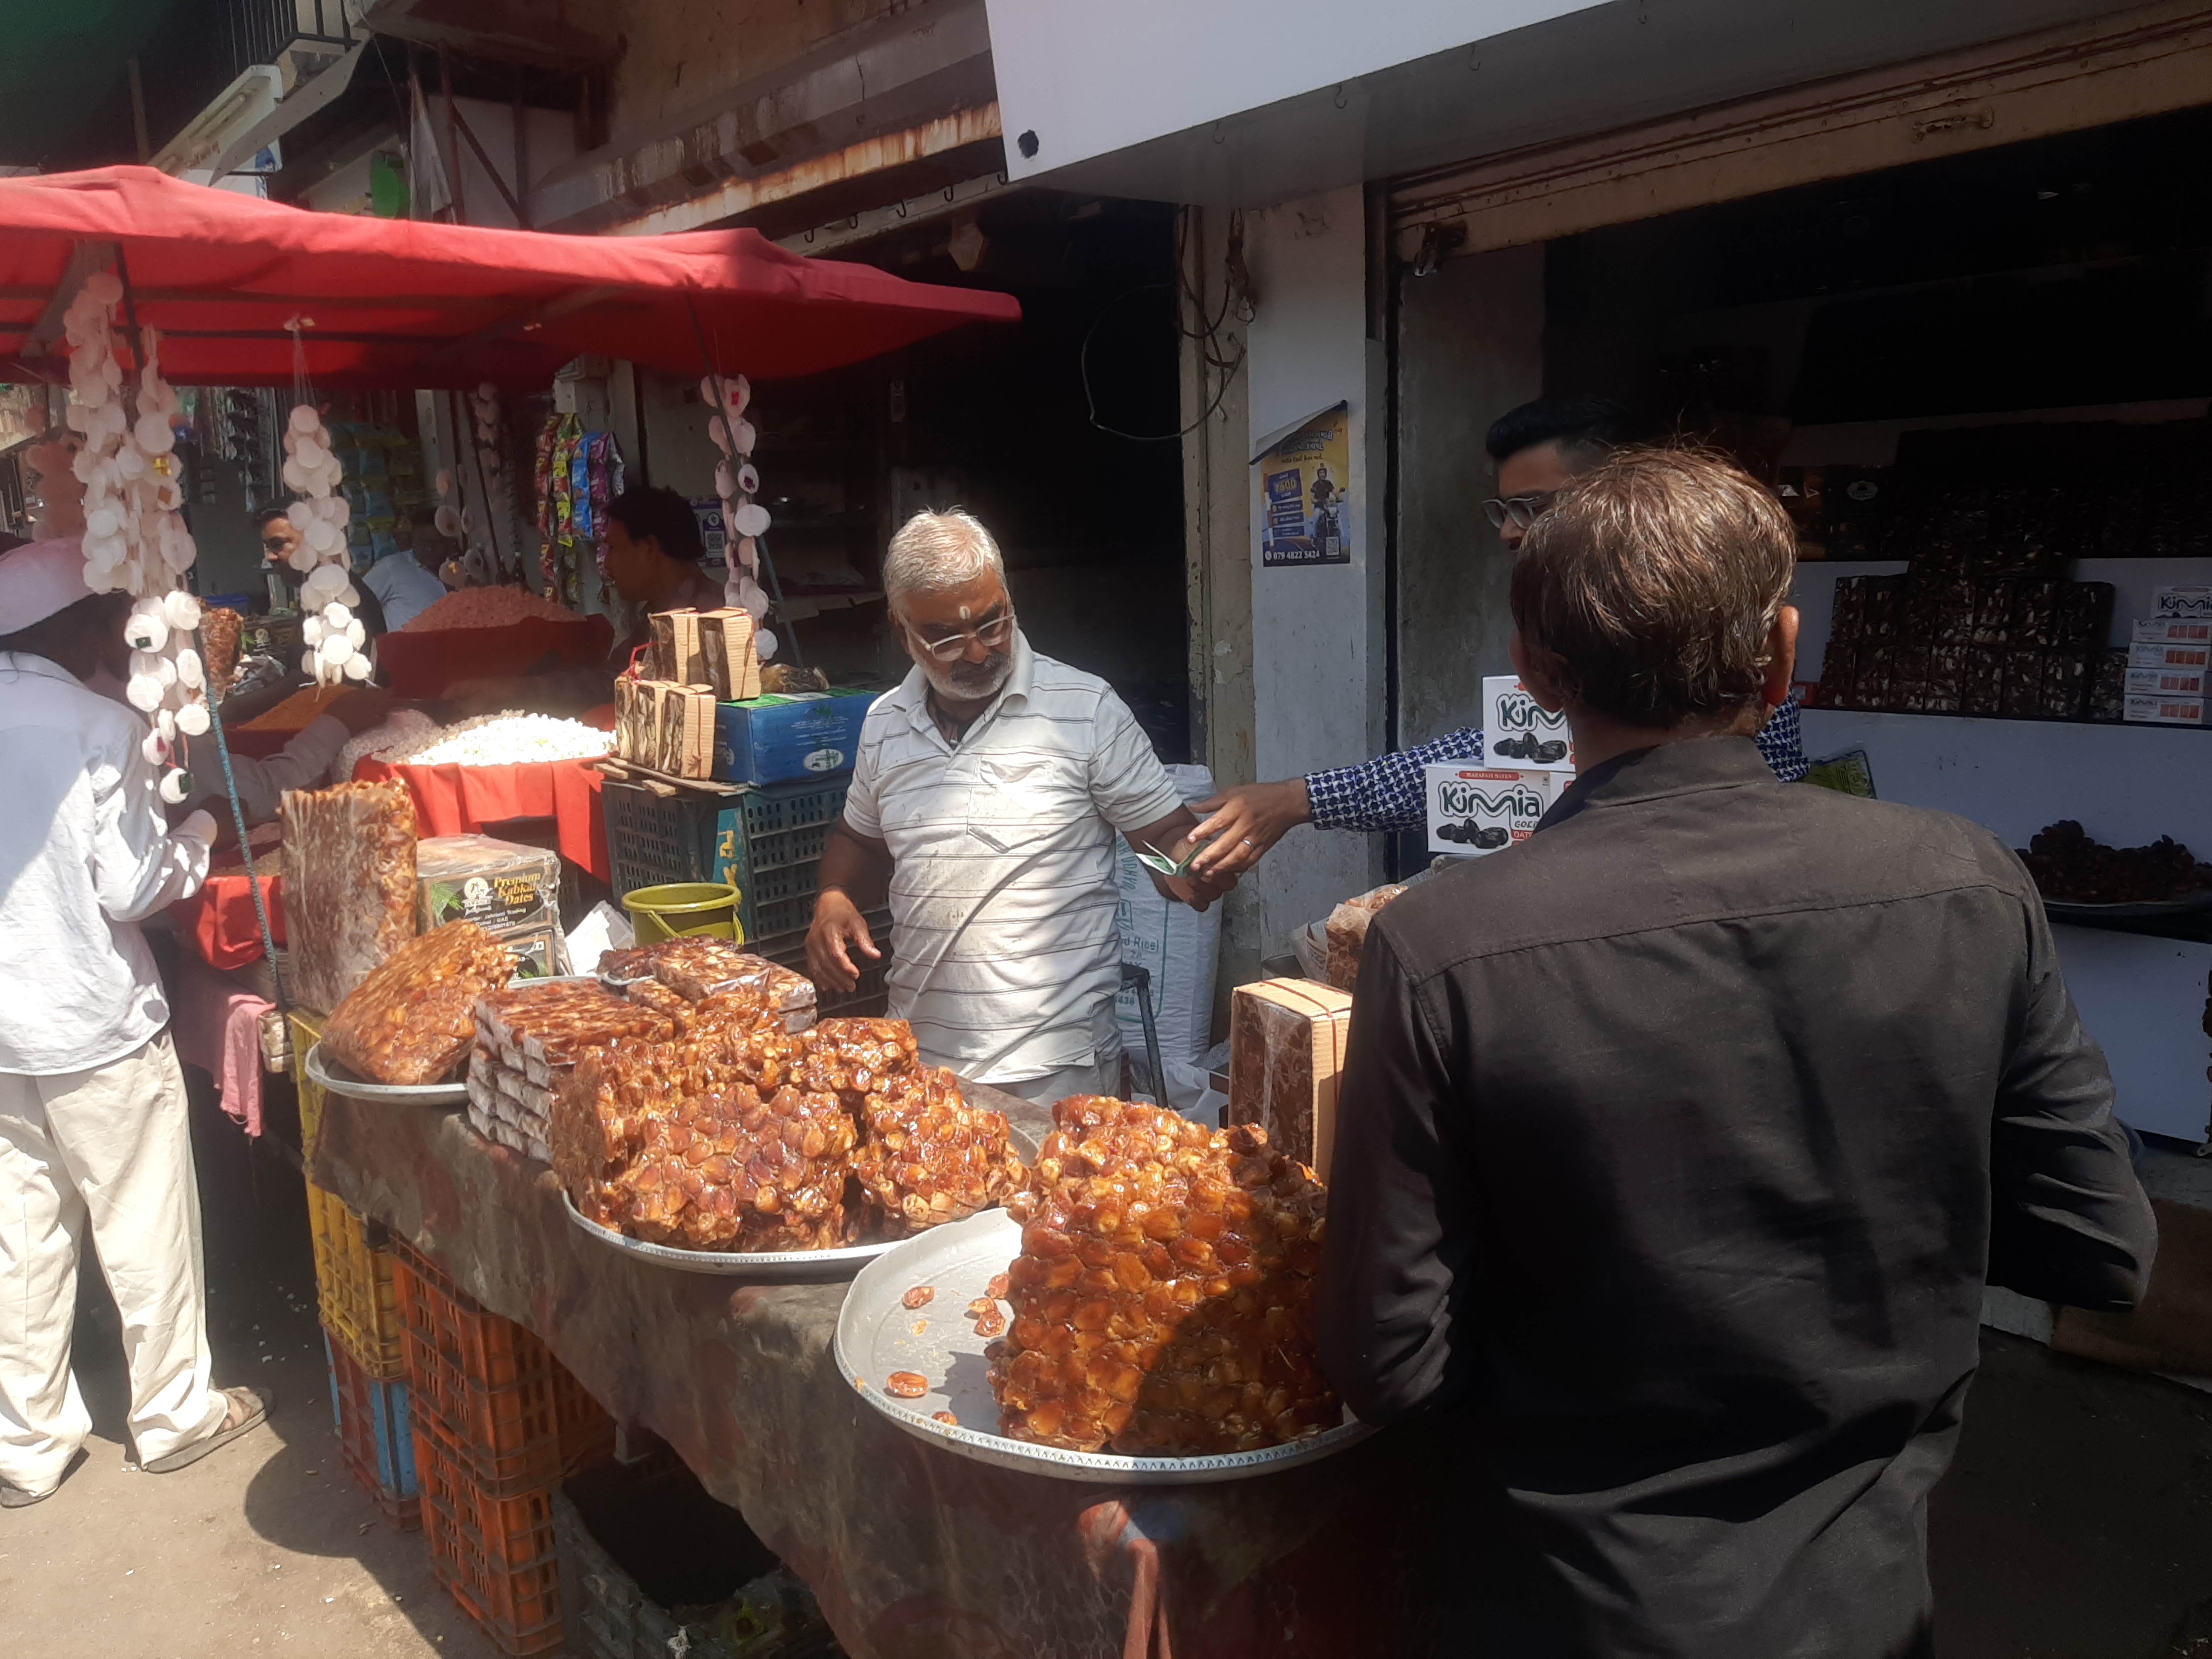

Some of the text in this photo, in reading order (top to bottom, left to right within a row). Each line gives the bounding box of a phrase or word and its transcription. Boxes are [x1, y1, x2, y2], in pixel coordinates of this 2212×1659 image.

[1501, 699, 1565, 727] Kim
[1442, 786, 1540, 817] Kimia
[494, 873, 541, 888] Premium
[505, 893, 534, 906] Dates
